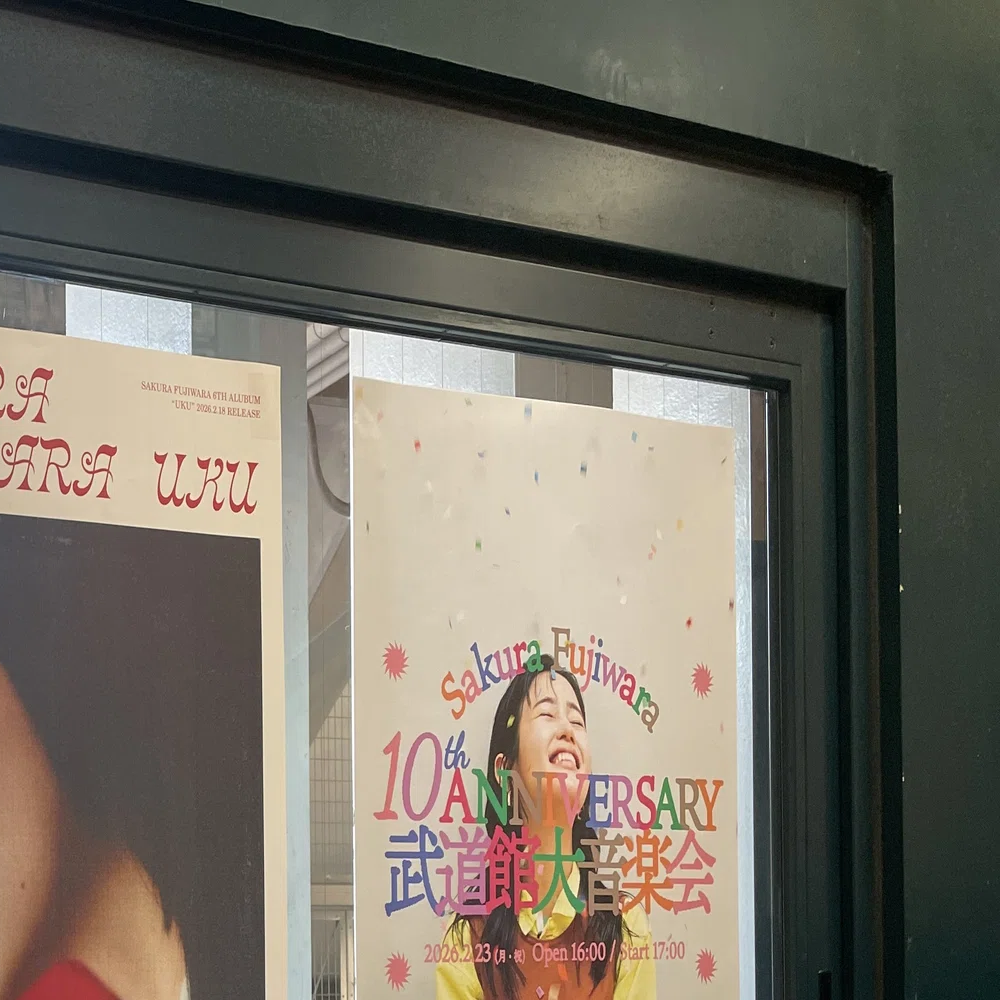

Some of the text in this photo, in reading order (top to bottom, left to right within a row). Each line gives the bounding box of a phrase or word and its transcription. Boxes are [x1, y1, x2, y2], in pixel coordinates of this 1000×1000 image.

[141, 381, 261, 404] SAKURA FUJIWARA 6TH ALUBUM
[196, 403, 226, 415] 2026.2.18
[227, 407, 261, 419] RELEASE
[153, 450, 259, 515] UKU
[441, 626, 659, 733] Sakura Fujiwara
[373, 730, 724, 832] 10th ANNIVERSARY
[383, 825, 717, 918] 武道館大音楽会
[424, 943, 492, 963] 2026.2.23
[532, 943, 568, 967] Open
[571, 942, 606, 962] 16:00
[620, 942, 649, 961] Start
[653, 941, 685, 960] 17:00
